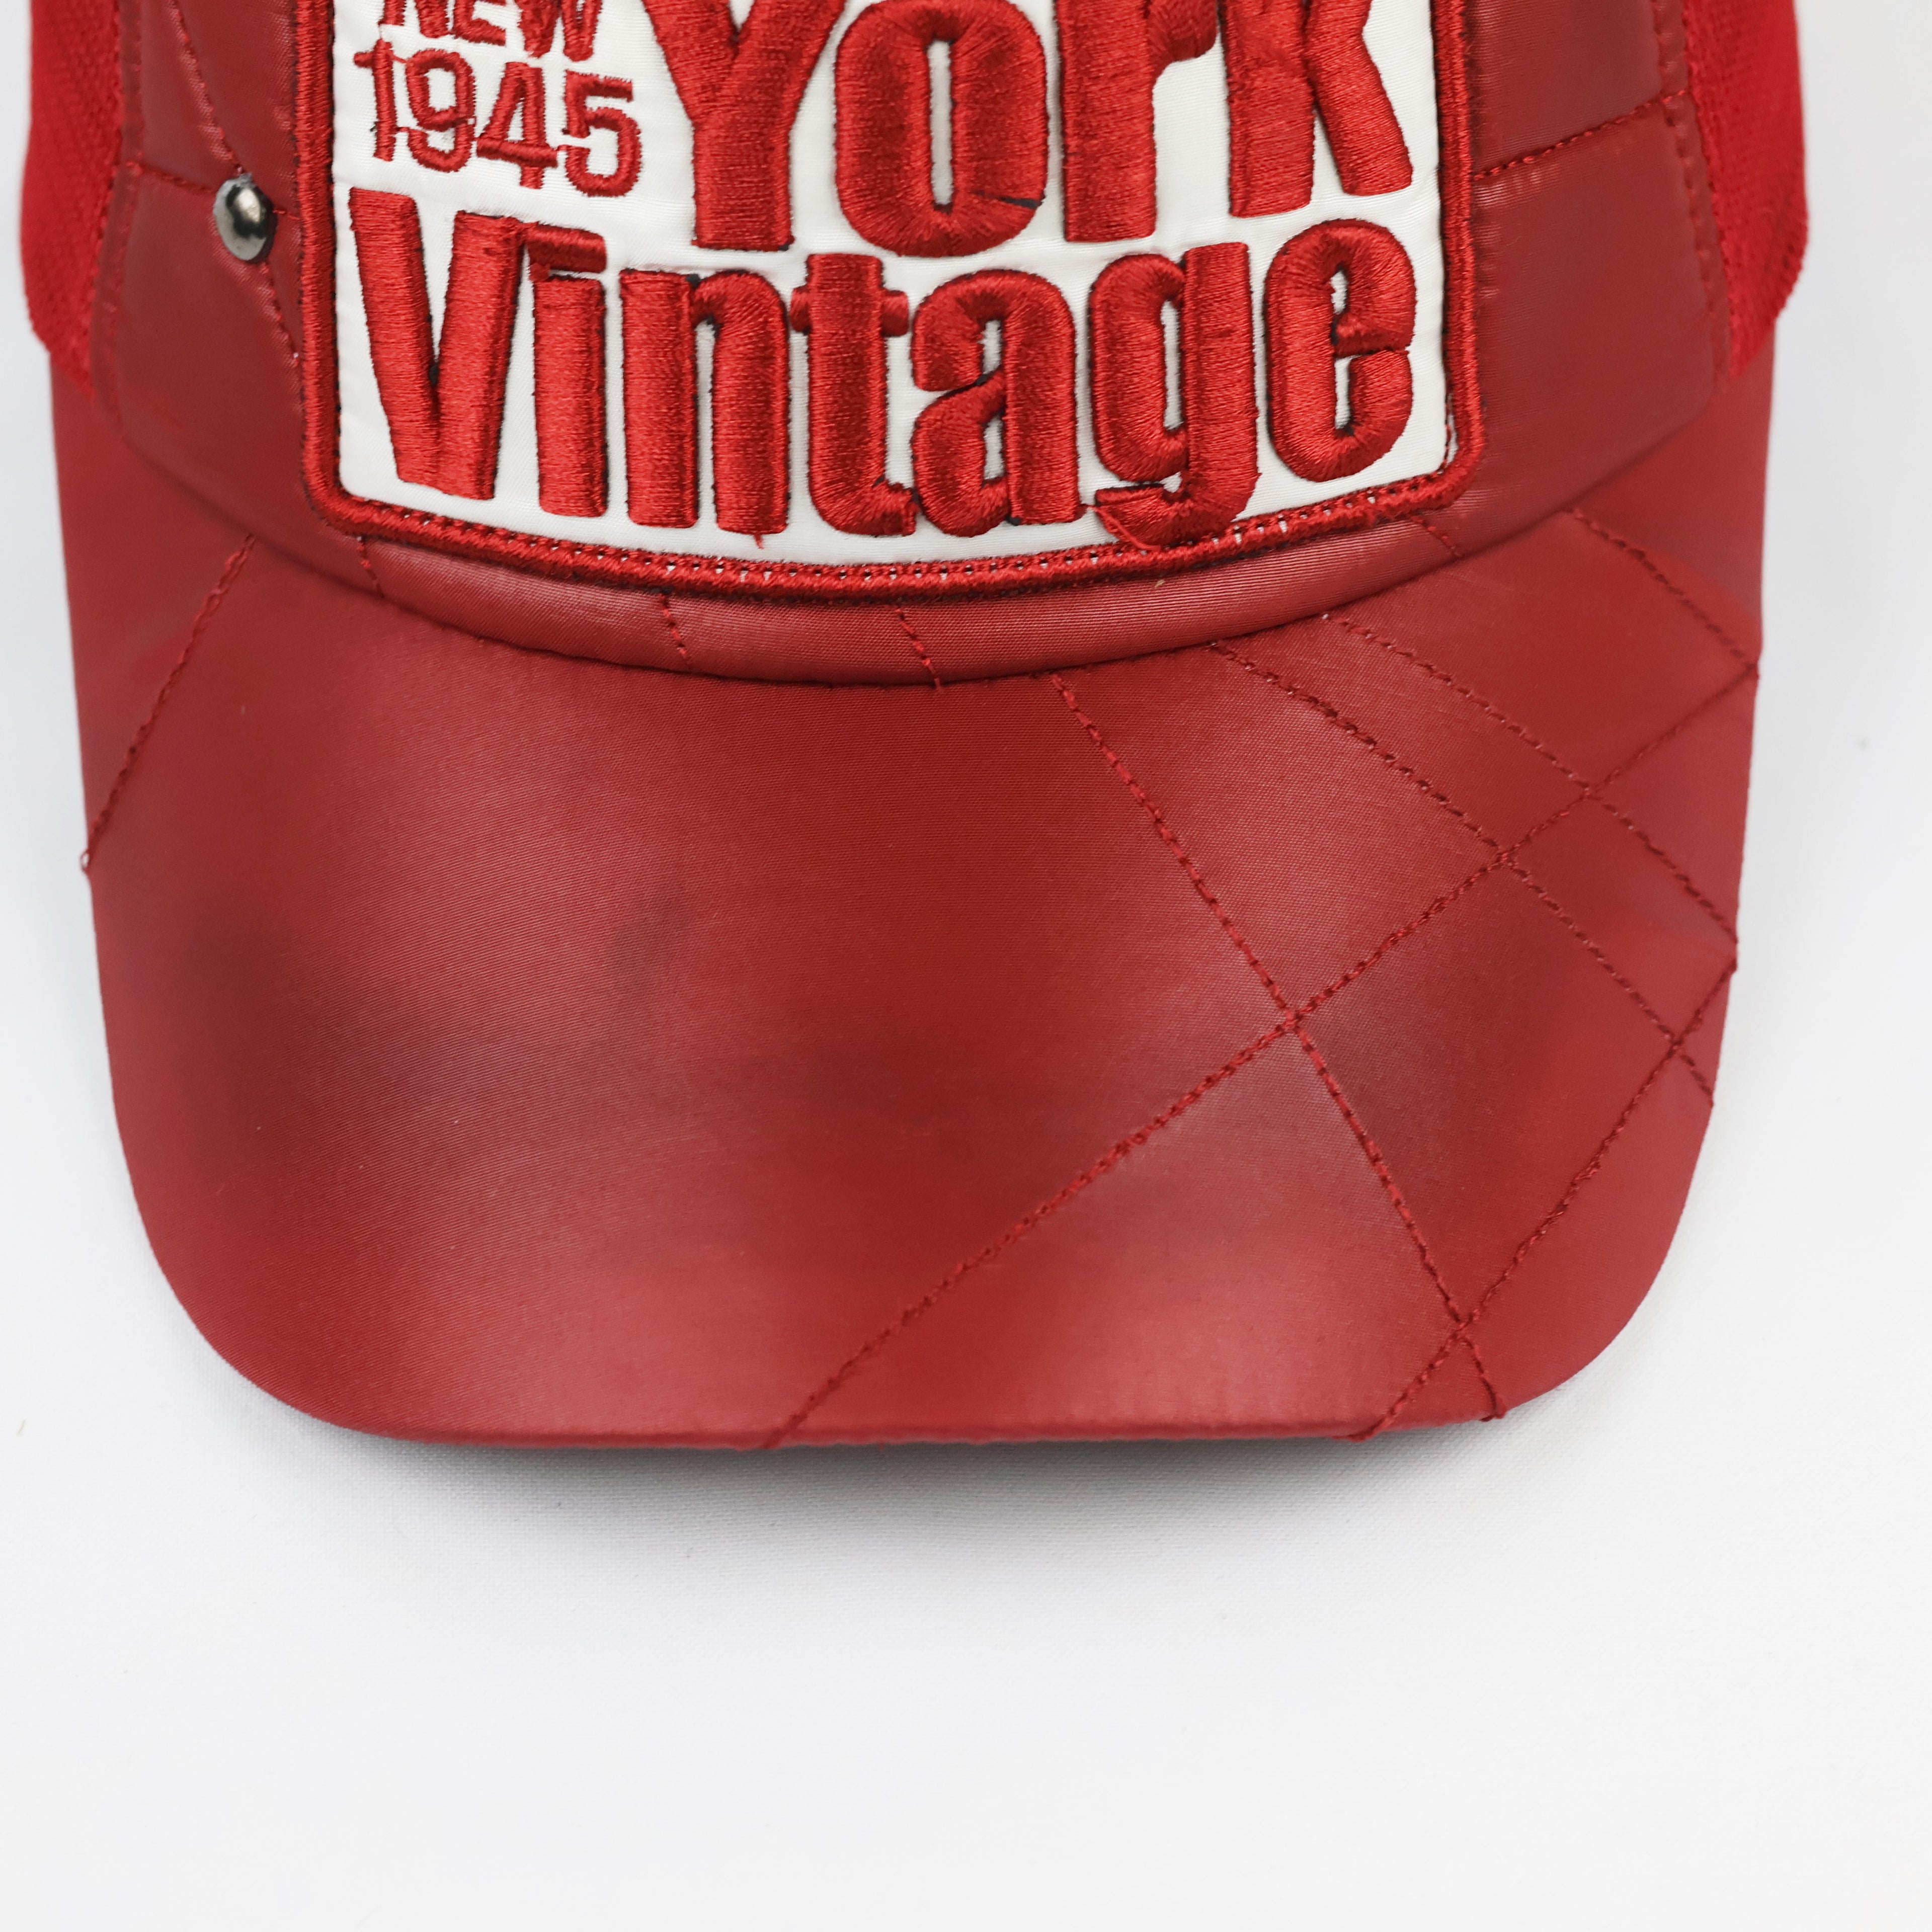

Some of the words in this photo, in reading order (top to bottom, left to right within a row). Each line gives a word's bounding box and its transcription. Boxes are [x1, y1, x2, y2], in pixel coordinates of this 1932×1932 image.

[354, 39, 642, 197] 1945
[644, 0, 1412, 257] York
[348, 187, 1417, 546] Vintage
